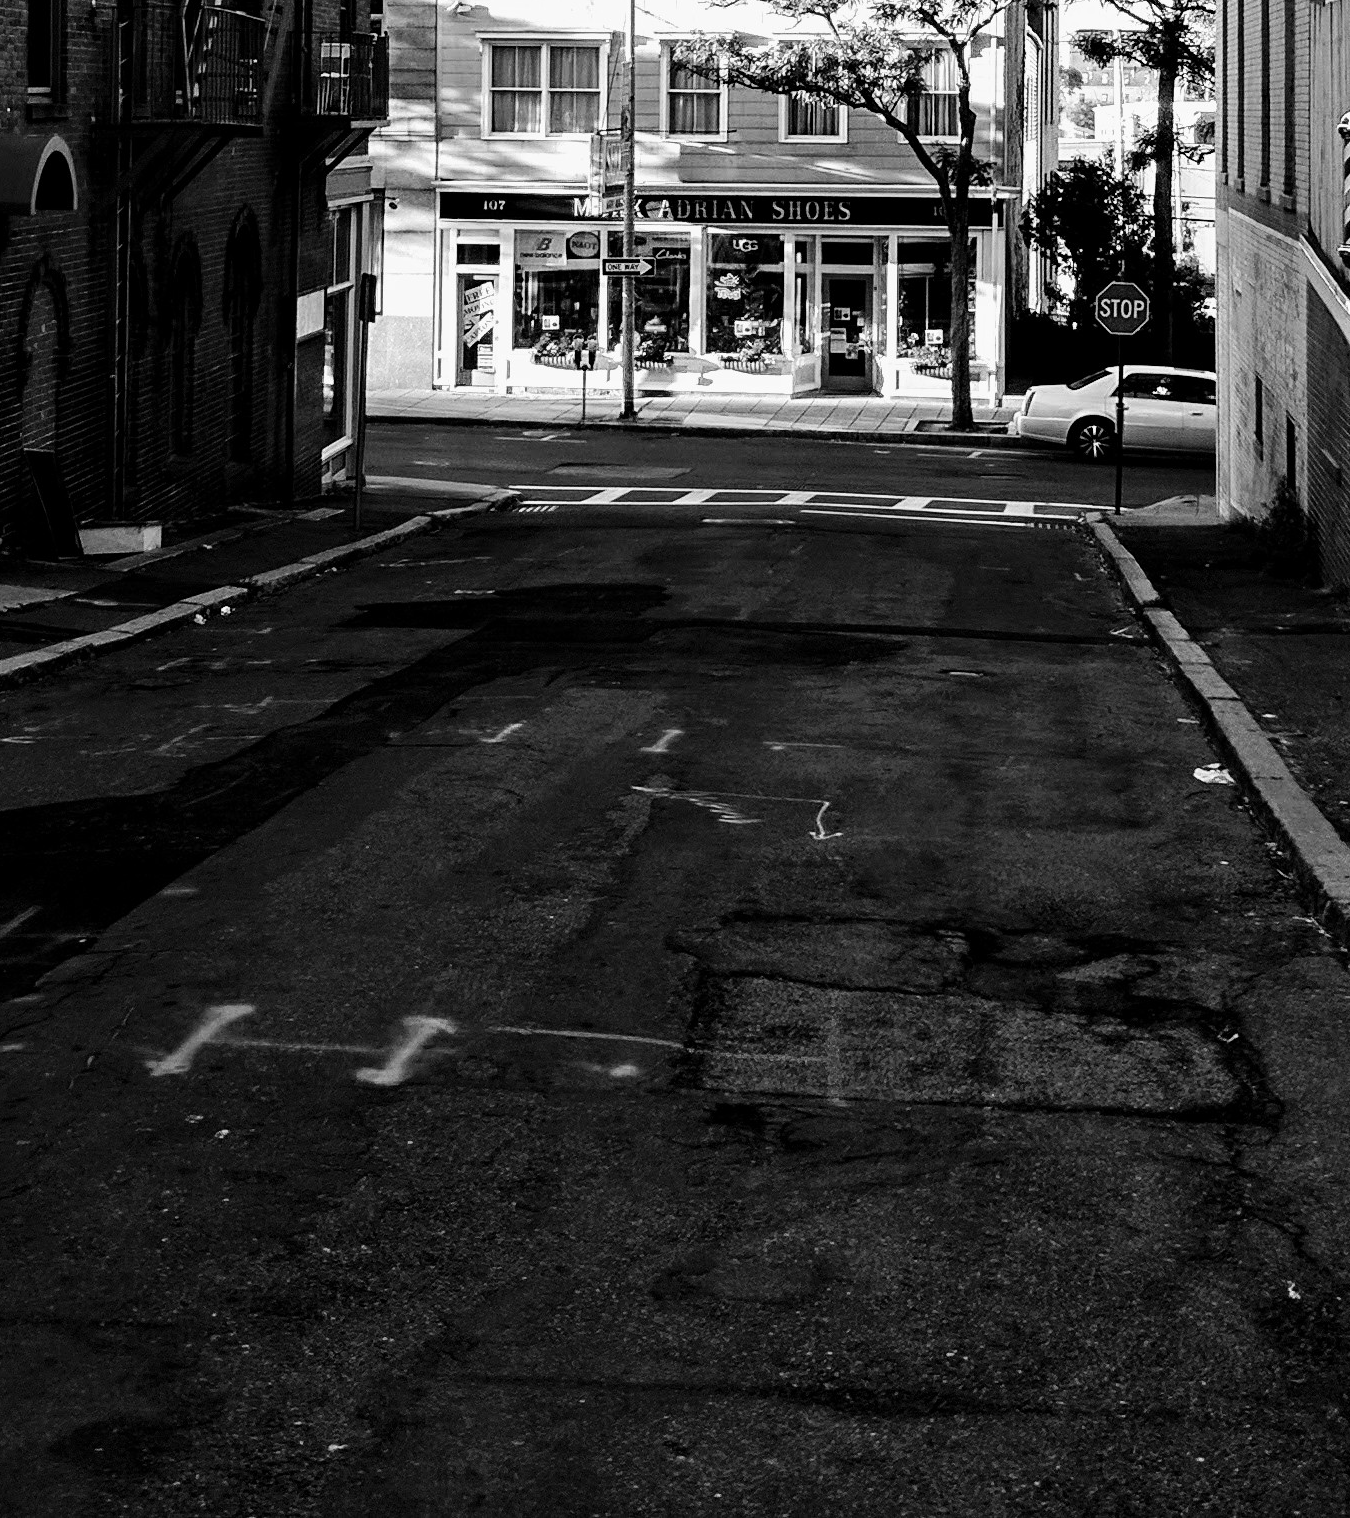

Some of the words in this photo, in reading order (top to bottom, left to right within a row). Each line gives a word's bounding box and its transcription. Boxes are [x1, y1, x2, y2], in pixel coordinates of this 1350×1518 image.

[483, 199, 506, 210] 107
[658, 199, 754, 220] ADRIAN
[772, 200, 851, 221] SHOES
[732, 239, 758, 252] UGG
[655, 248, 687, 260] Clarks
[607, 263, 622, 271] ONE
[624, 263, 640, 271] WAY
[466, 286, 491, 302] FREE
[1100, 298, 1145, 319] STOP
